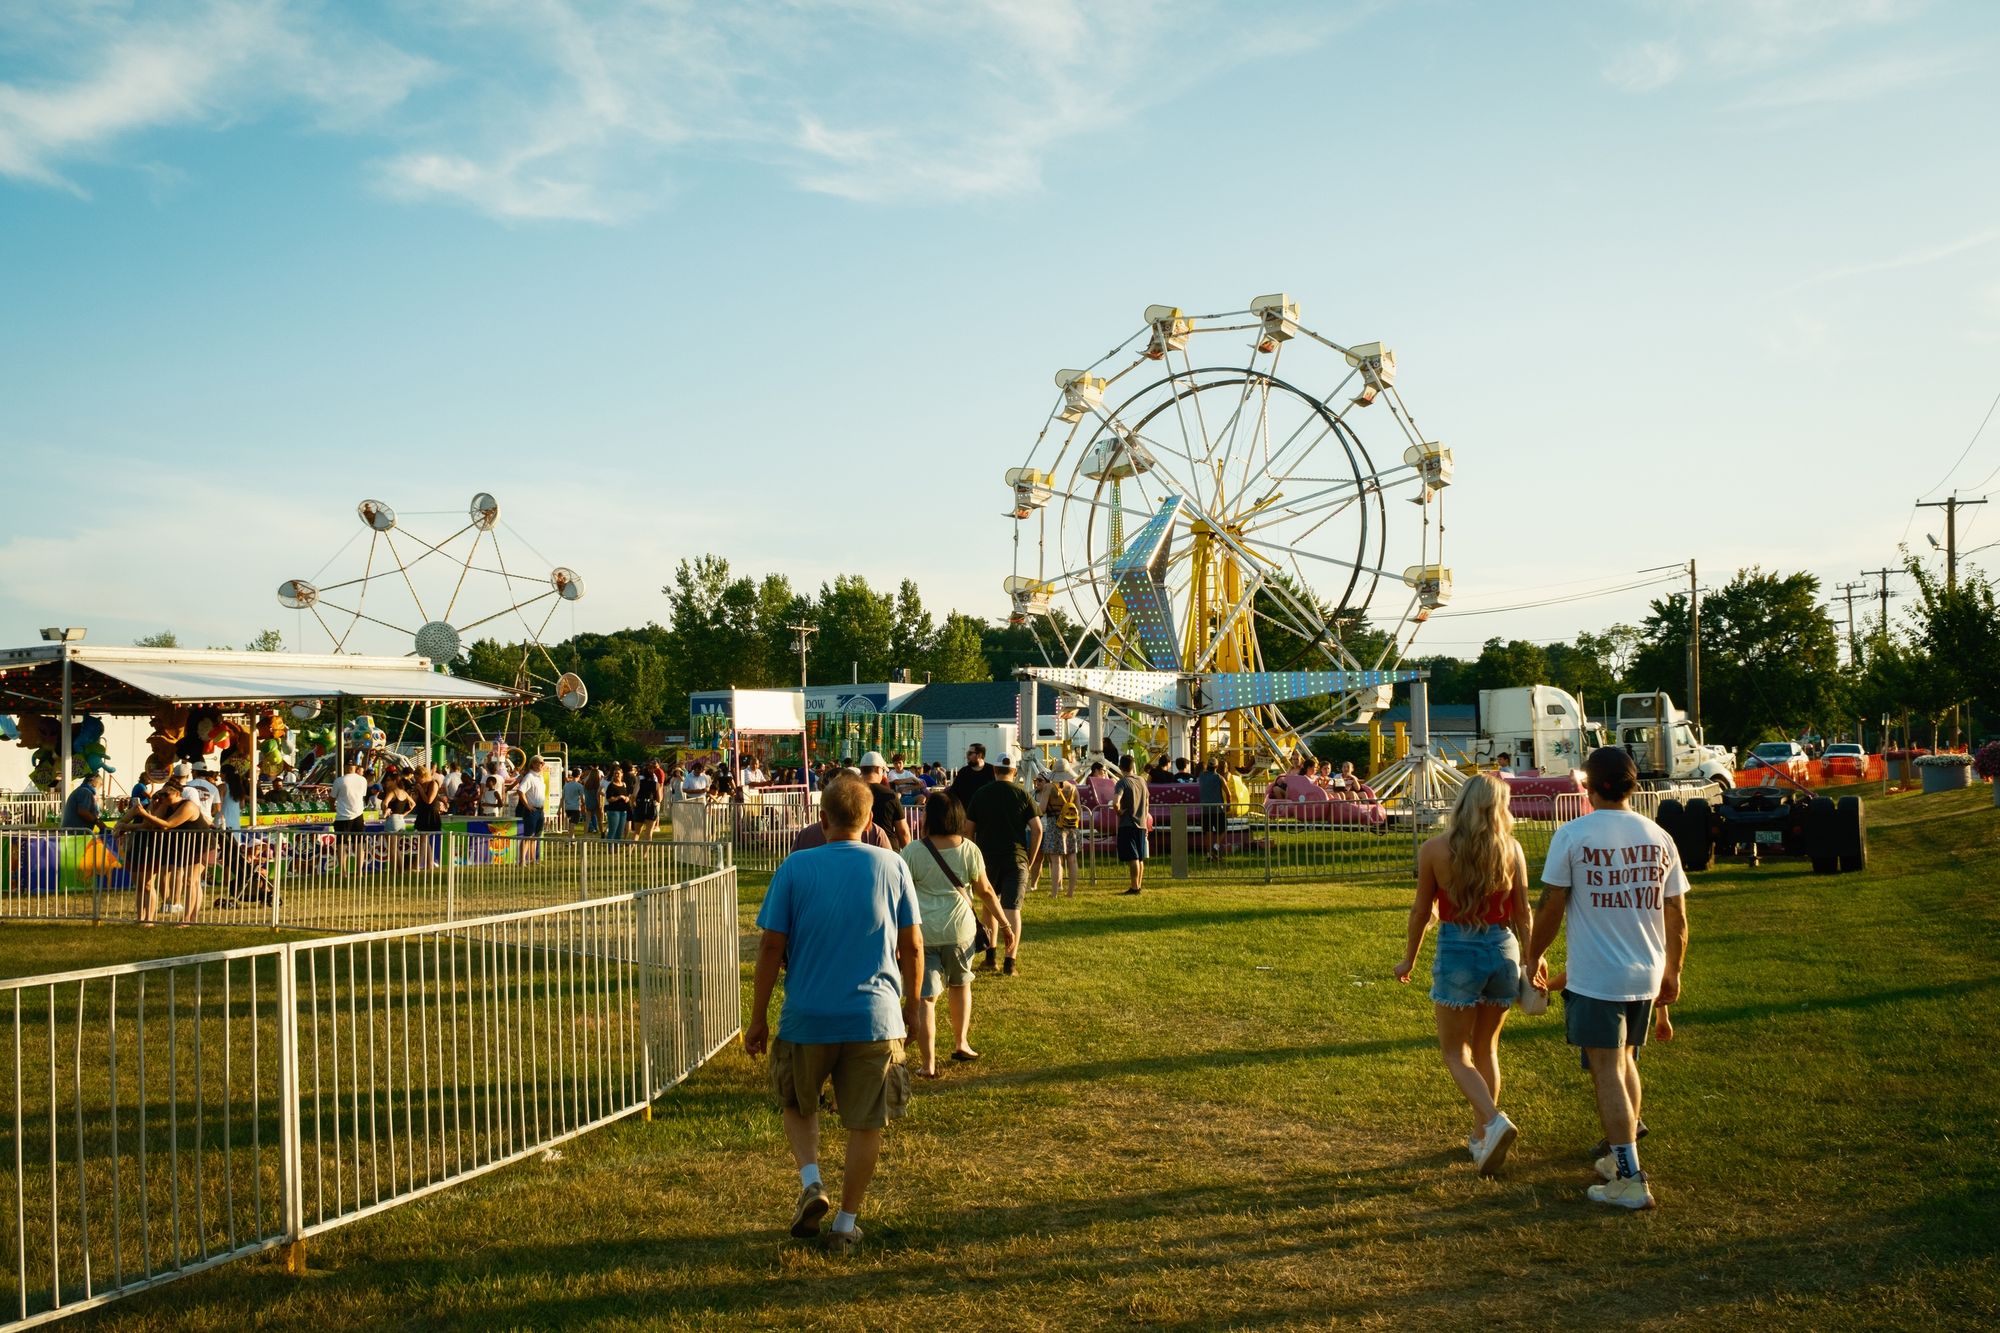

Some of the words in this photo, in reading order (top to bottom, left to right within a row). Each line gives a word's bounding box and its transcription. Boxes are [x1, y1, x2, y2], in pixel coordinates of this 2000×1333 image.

[1582, 846, 1615, 867] MY
[1586, 869, 1603, 887] IS
[1590, 889, 1634, 909] THAN
